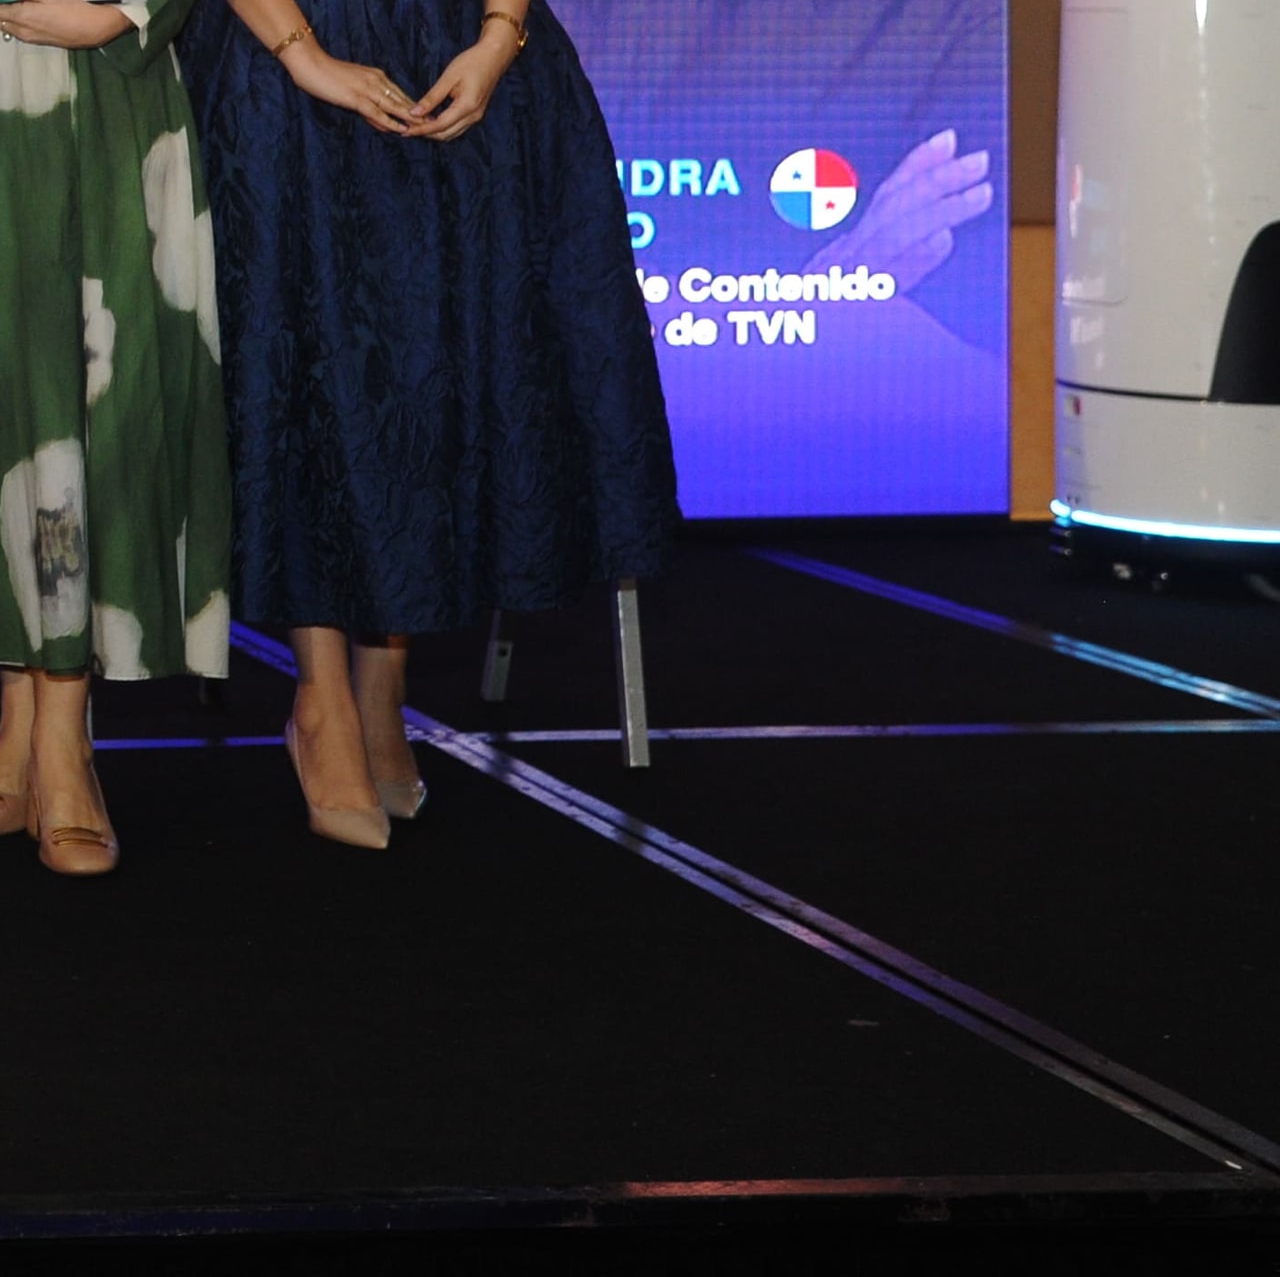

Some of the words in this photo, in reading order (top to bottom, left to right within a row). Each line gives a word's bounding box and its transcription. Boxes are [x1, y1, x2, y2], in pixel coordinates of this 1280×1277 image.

[615, 158, 741, 197] DRA
[678, 264, 896, 303] Contenido
[664, 311, 718, 347] de
[726, 309, 816, 346] TVN
